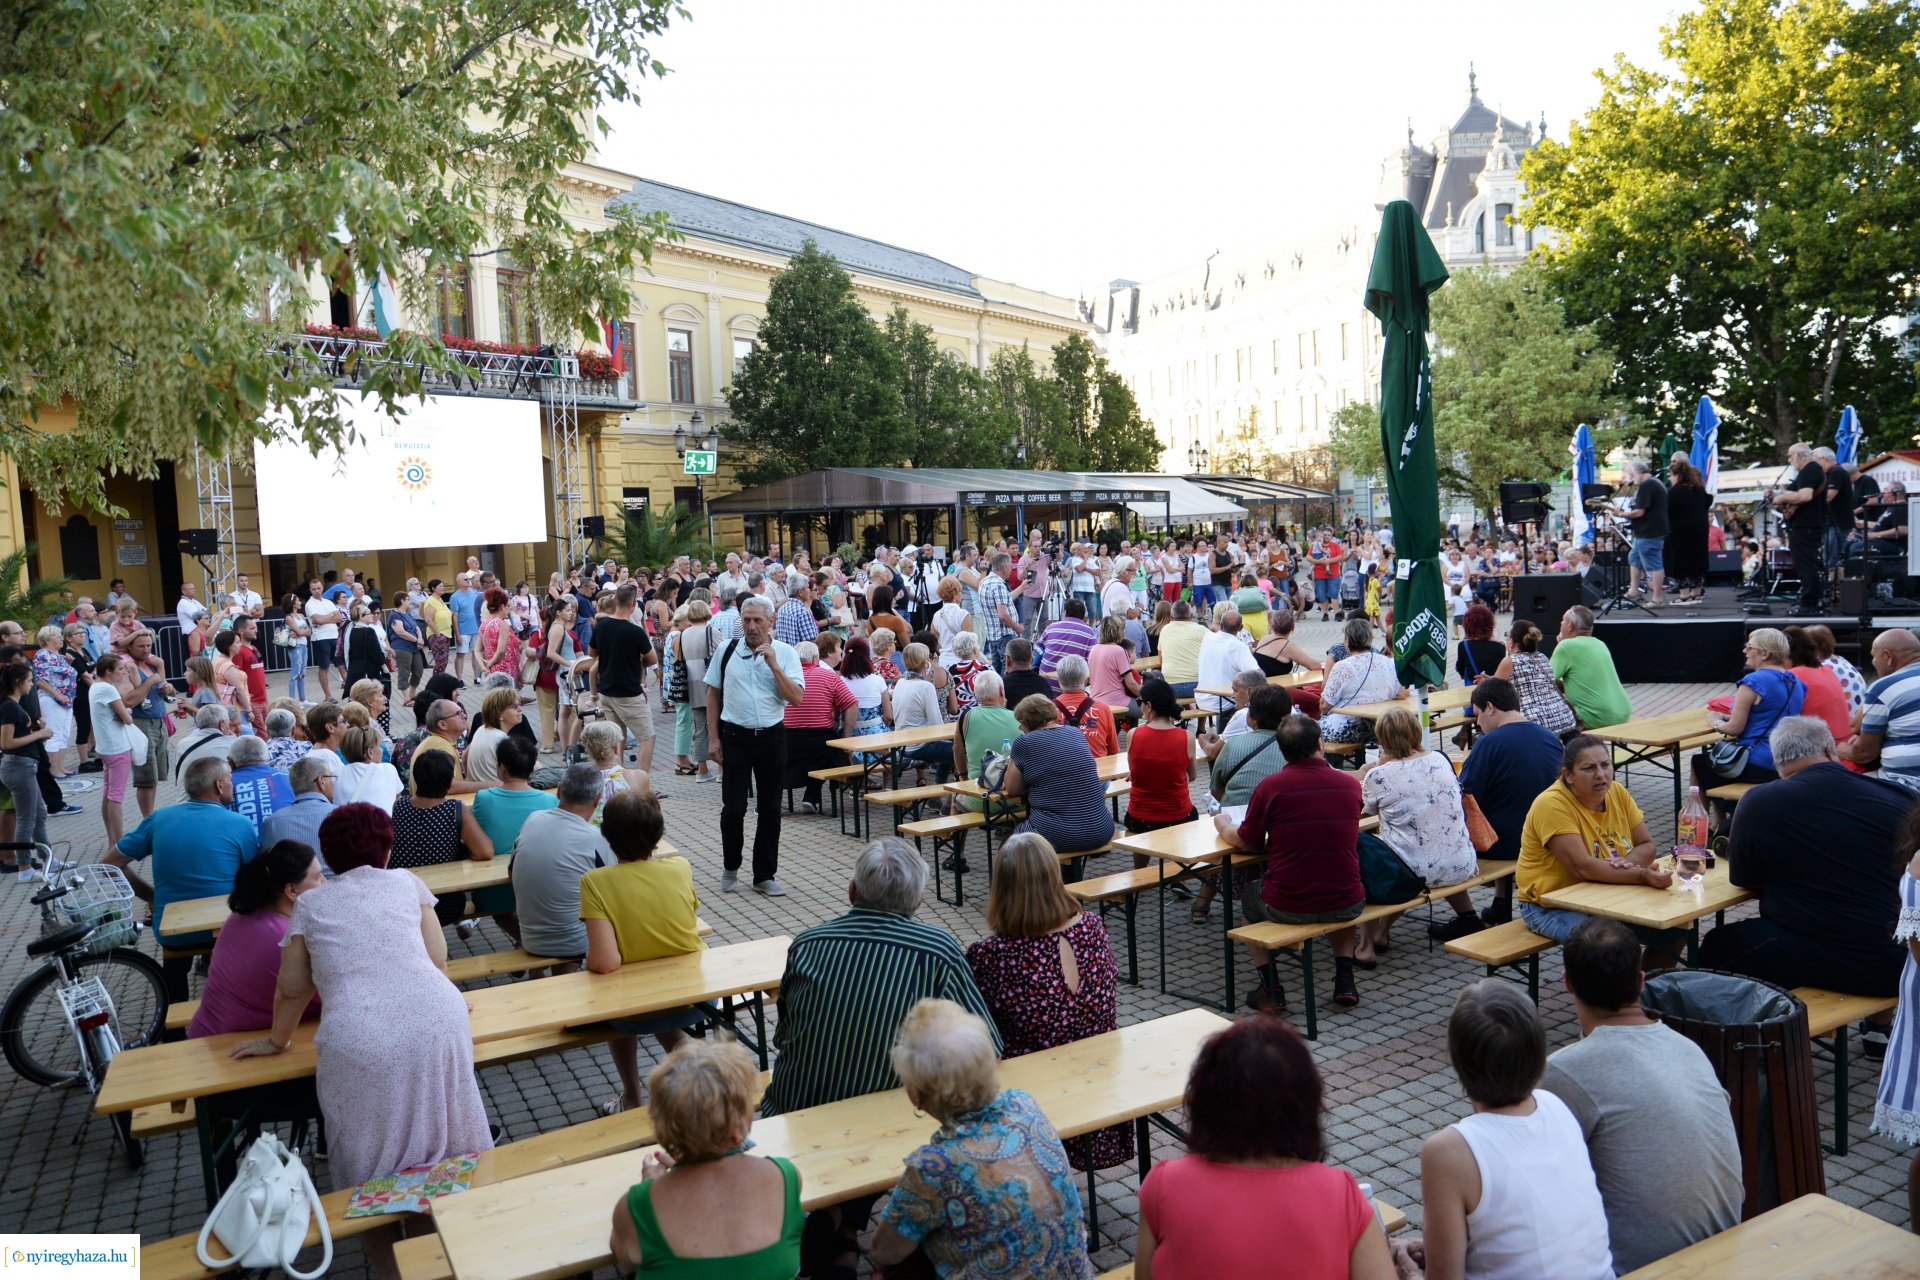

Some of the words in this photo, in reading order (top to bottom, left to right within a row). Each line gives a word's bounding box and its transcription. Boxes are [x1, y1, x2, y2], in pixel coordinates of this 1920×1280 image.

[995, 494, 1010, 503] PIZZA
[1012, 494, 1025, 502] WINE
[1027, 494, 1047, 502] COFFEE
[1048, 493, 1062, 502] BEER
[1095, 492, 1108, 500] PIZZA
[1111, 492, 1121, 500] BOR
[1429, 623, 1447, 650] 1880
[257, 778, 272, 821] ETITION
